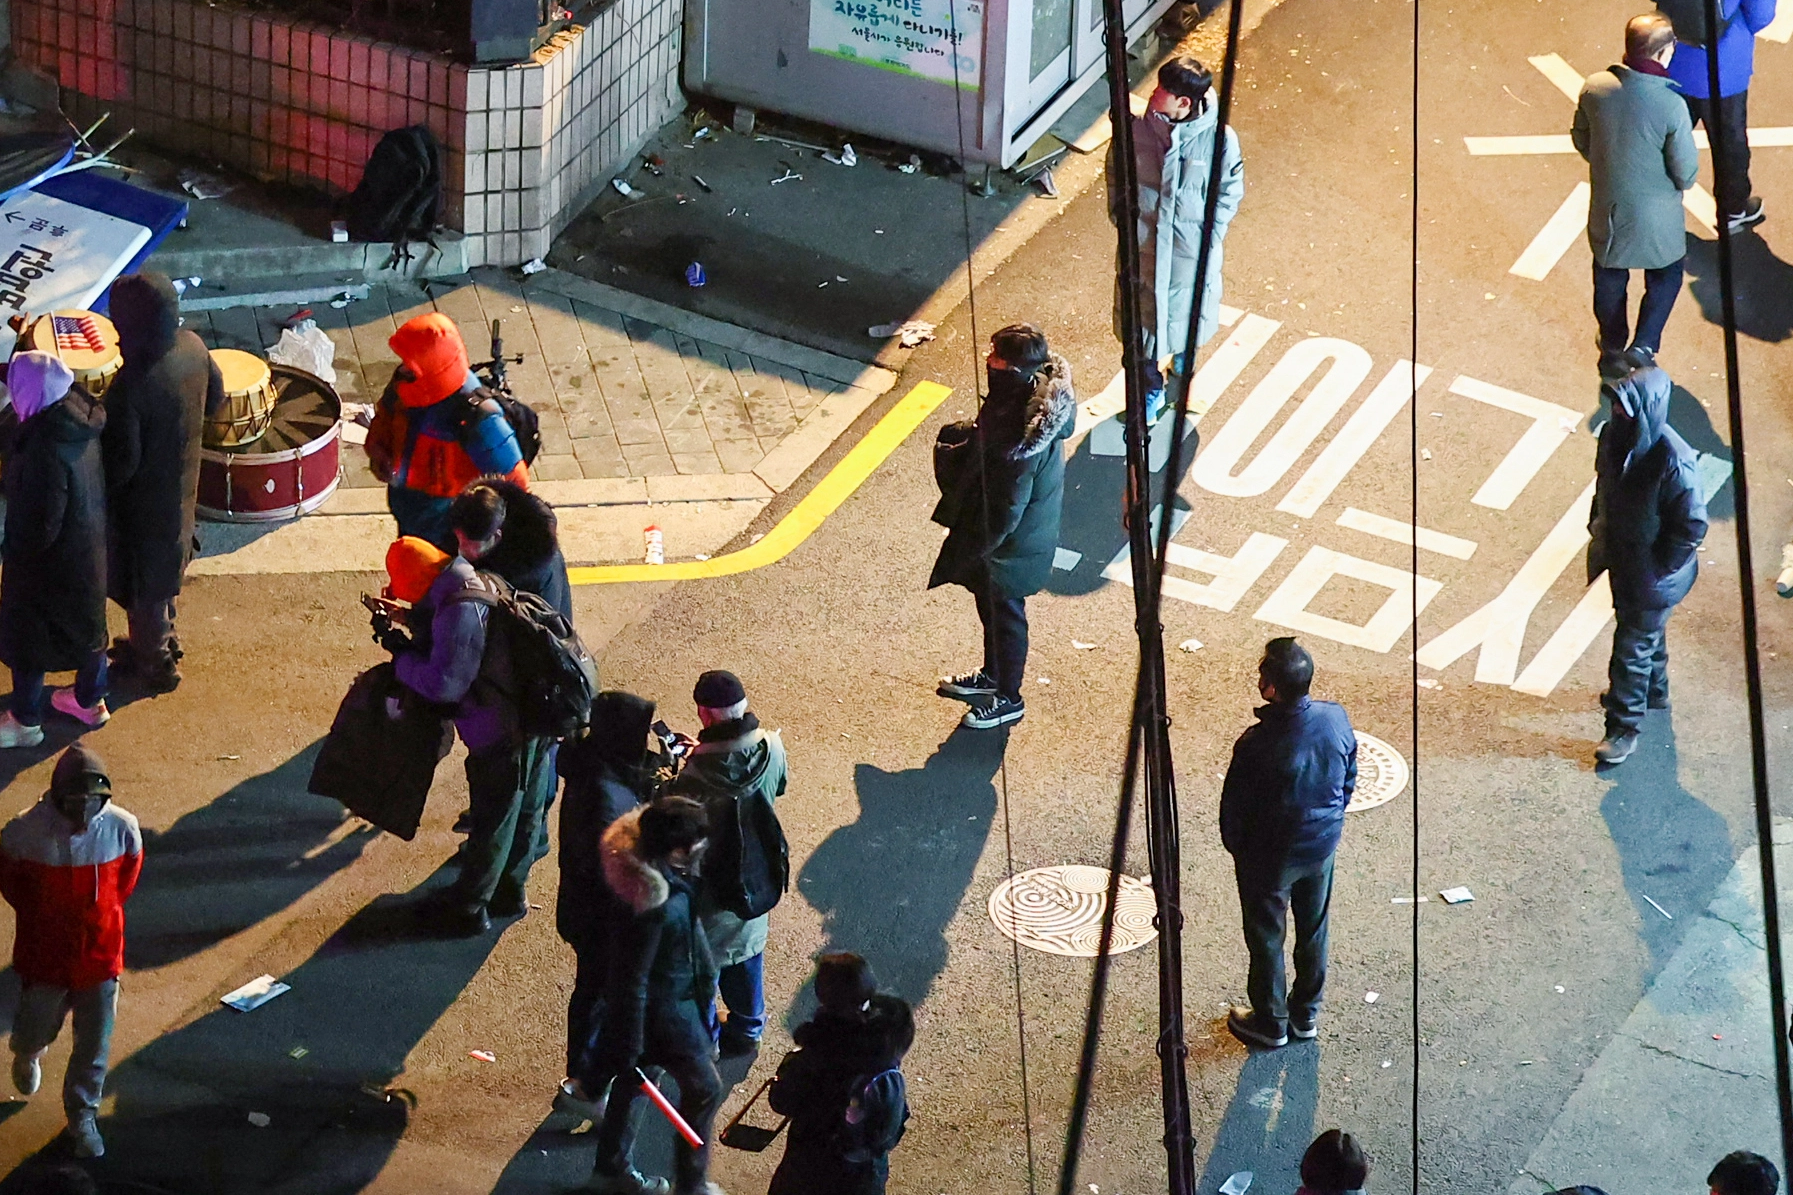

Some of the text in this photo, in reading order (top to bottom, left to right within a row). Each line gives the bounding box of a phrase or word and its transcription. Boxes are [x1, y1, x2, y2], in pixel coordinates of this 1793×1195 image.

[834, 0, 963, 47] 자유롭게 다니기를!
[851, 25, 945, 57] 서울시가 응원합니다
